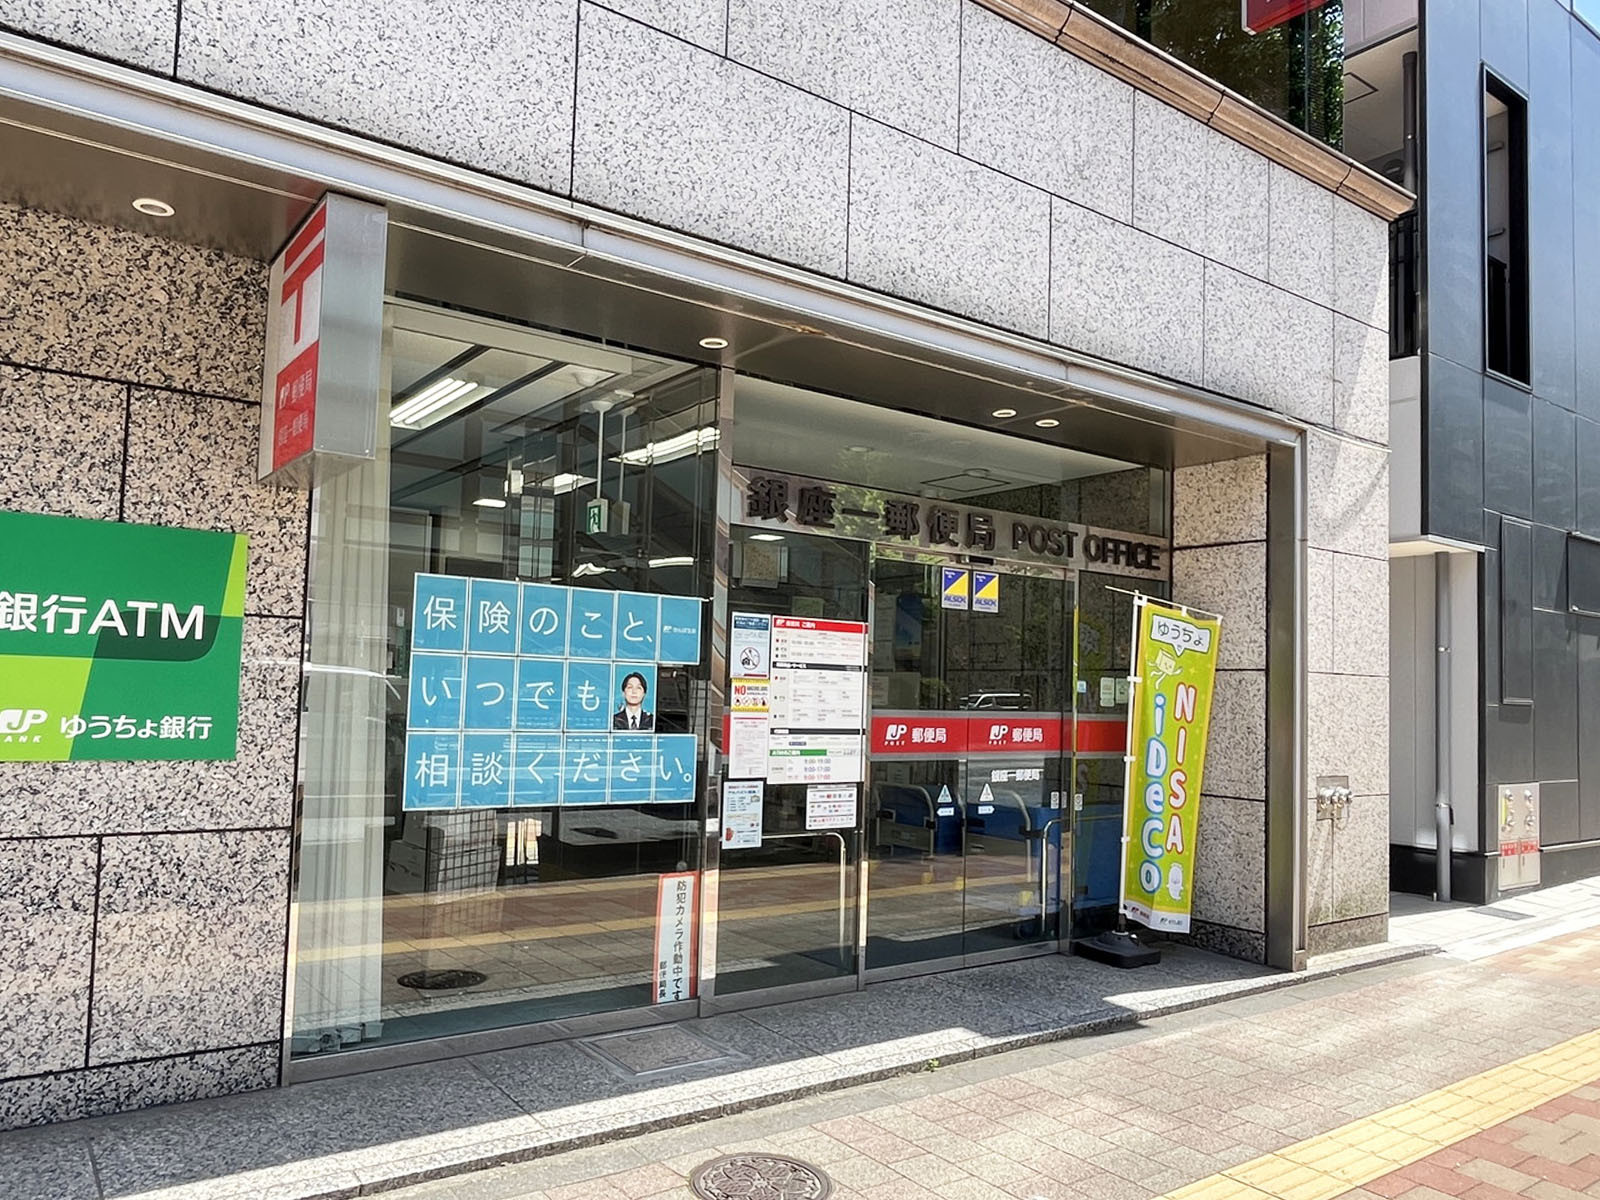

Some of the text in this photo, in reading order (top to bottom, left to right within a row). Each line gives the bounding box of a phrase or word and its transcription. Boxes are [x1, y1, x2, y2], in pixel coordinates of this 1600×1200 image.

[747, 476, 1161, 571] 銀座一郵便局 POST OFFICE
[423, 595, 653, 643] 保険のこと、
[1157, 621, 1204, 647] ゆうちょ
[421, 676, 601, 713] いつでも
[734, 685, 746, 696] NO
[60, 714, 212, 740] ゆうちょ銀行
[911, 727, 947, 744] 郵便局
[1012, 727, 1044, 743] 郵便局
[415, 751, 692, 788] 相談ください。
[1166, 682, 1198, 854] NISA
[1139, 692, 1168, 894] iDeCo
[671, 879, 687, 1001] 防犯カメラ作動中です
